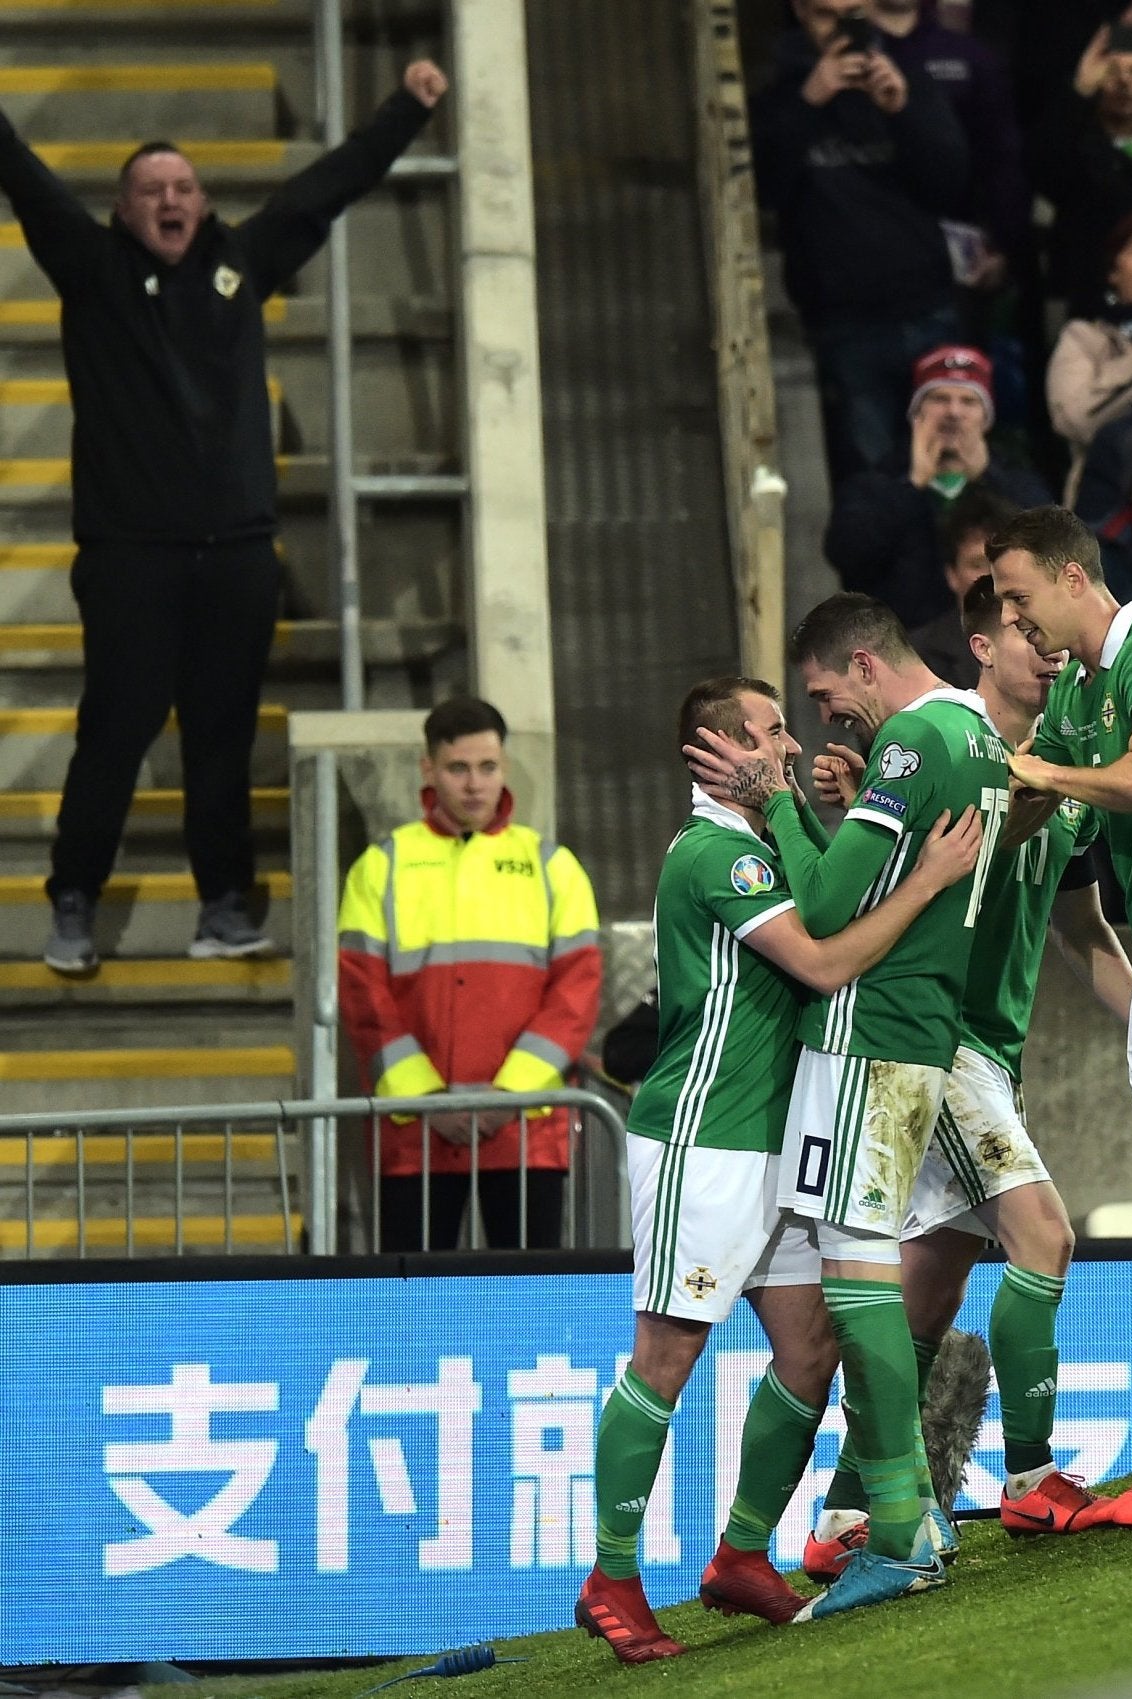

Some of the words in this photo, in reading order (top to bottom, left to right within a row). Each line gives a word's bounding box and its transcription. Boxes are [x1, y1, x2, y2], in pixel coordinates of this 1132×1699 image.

[870, 792, 906, 814] RESPECT
[796, 1134, 831, 1197] 0
[858, 1199, 886, 1212] adidas
